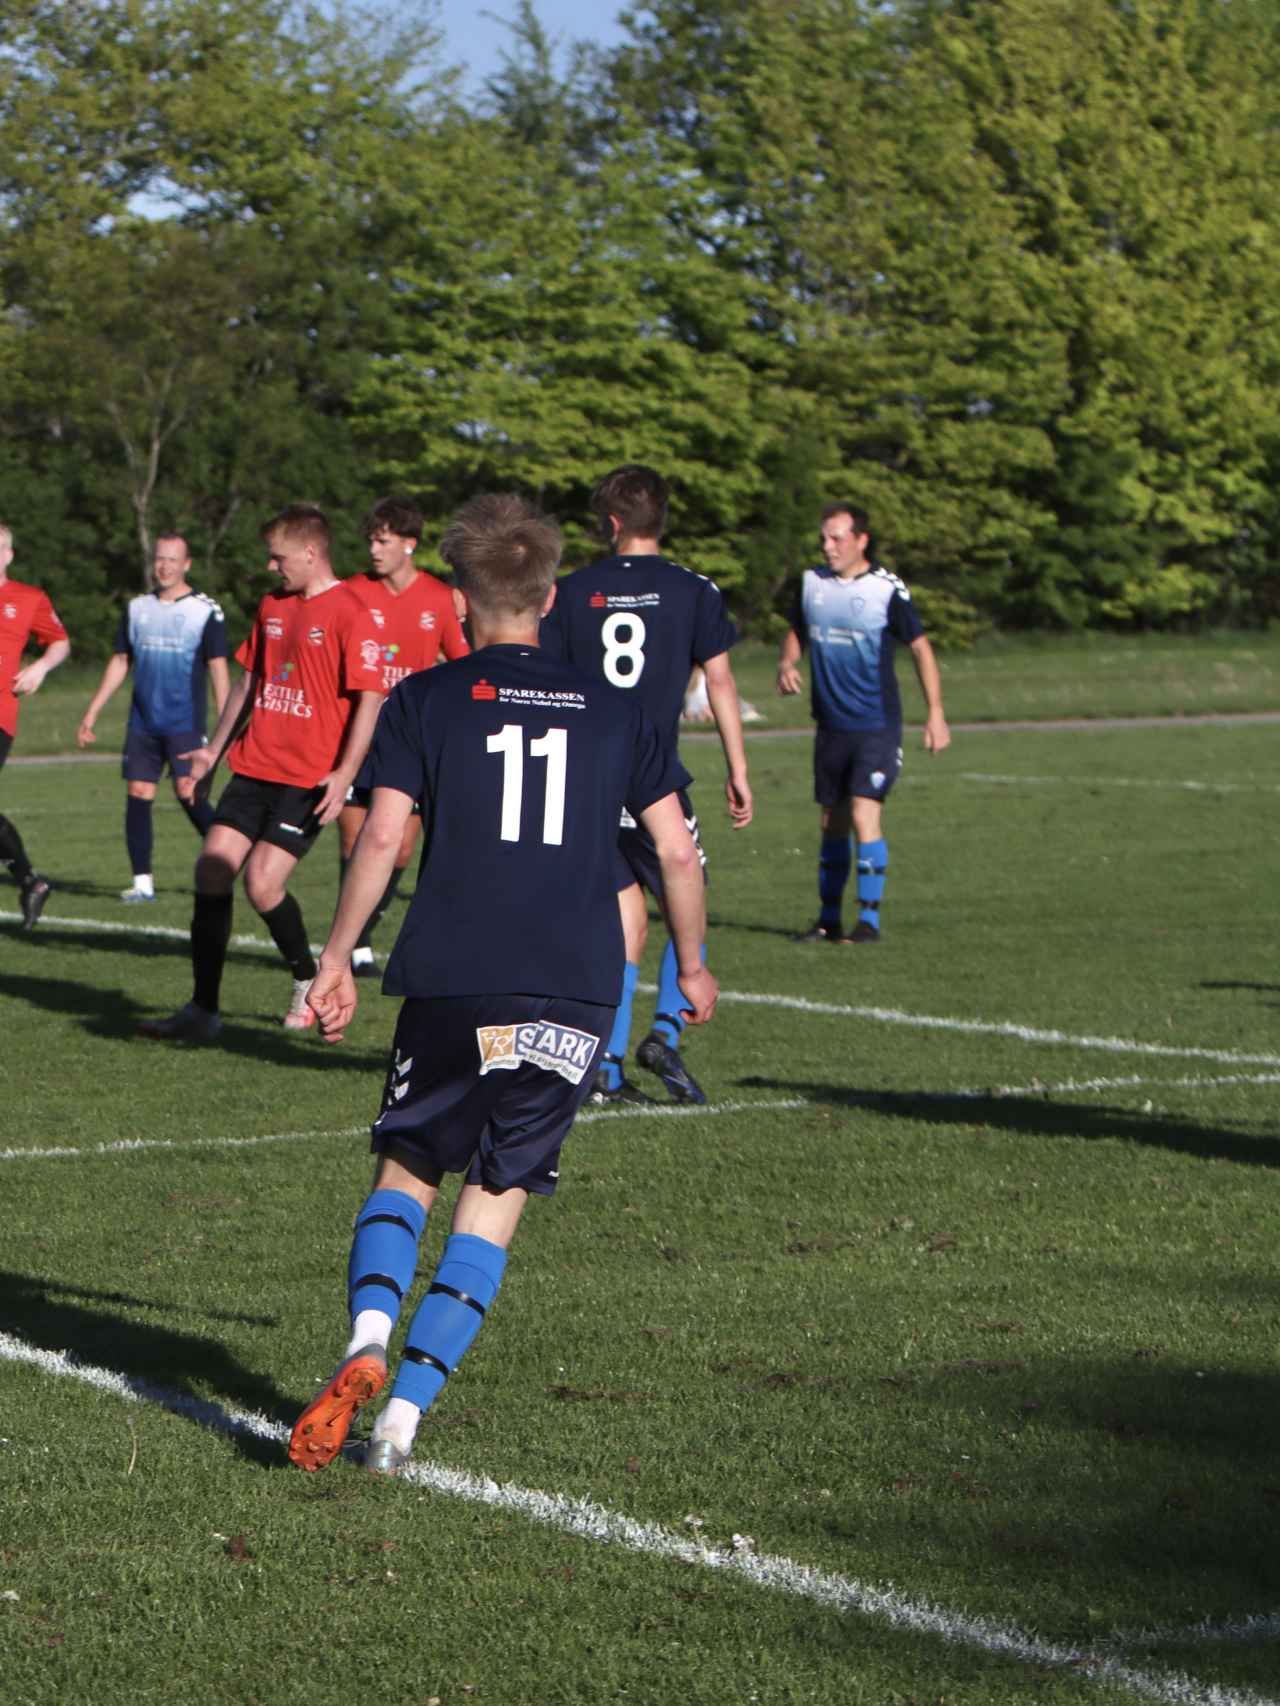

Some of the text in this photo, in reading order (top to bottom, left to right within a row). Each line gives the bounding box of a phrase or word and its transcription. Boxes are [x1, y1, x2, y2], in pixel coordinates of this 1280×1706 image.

[602, 612, 646, 688] 8
[263, 683, 304, 703] EXTILE
[499, 688, 585, 702] SPAREKASSEN
[487, 724, 568, 846] 11
[518, 1026, 593, 1067] SARK
